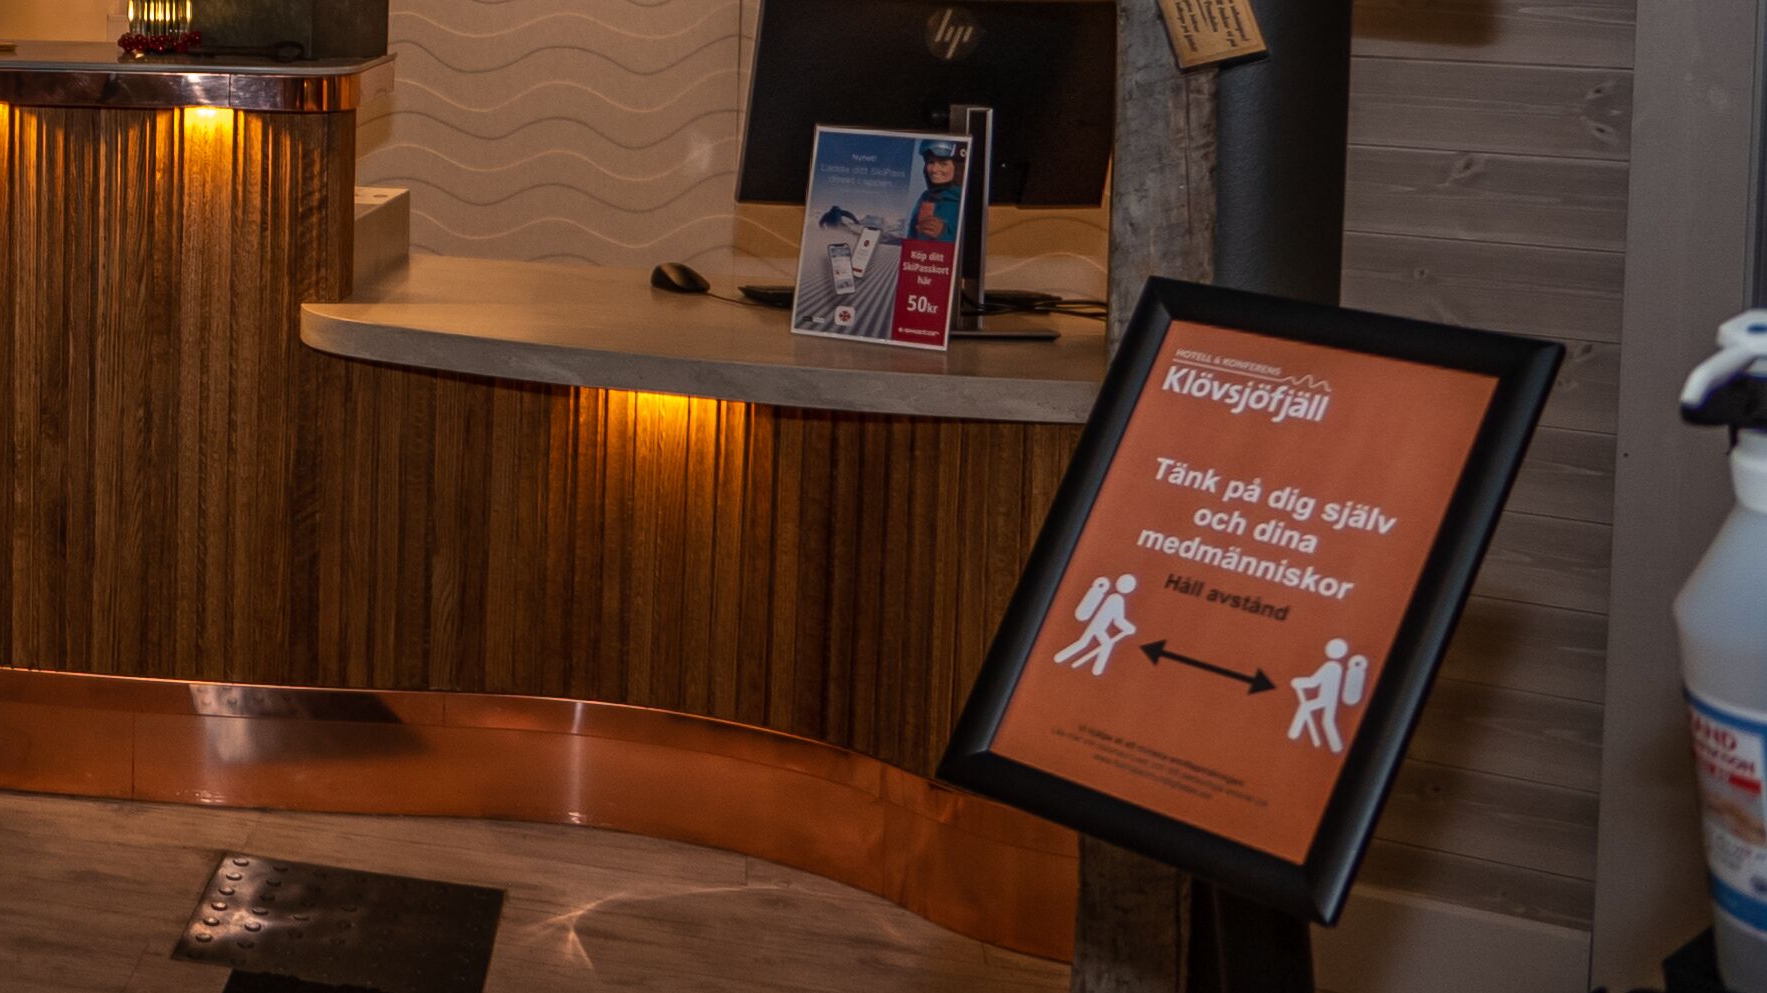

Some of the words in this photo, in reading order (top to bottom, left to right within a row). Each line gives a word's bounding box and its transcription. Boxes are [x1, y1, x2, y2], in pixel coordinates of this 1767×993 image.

[934, 7, 973, 59] hp
[1162, 365, 1331, 423] Klövsjöfjäll
[1155, 457, 1221, 493] Tänk
[1222, 477, 1261, 503] på
[1267, 486, 1316, 521] dig
[1321, 500, 1398, 534] själv
[1193, 507, 1247, 536] och
[1253, 519, 1318, 554] dina
[1136, 528, 1355, 600] medmänniskor
[1164, 573, 1203, 598] Håll
[1206, 585, 1290, 622] avstånd
